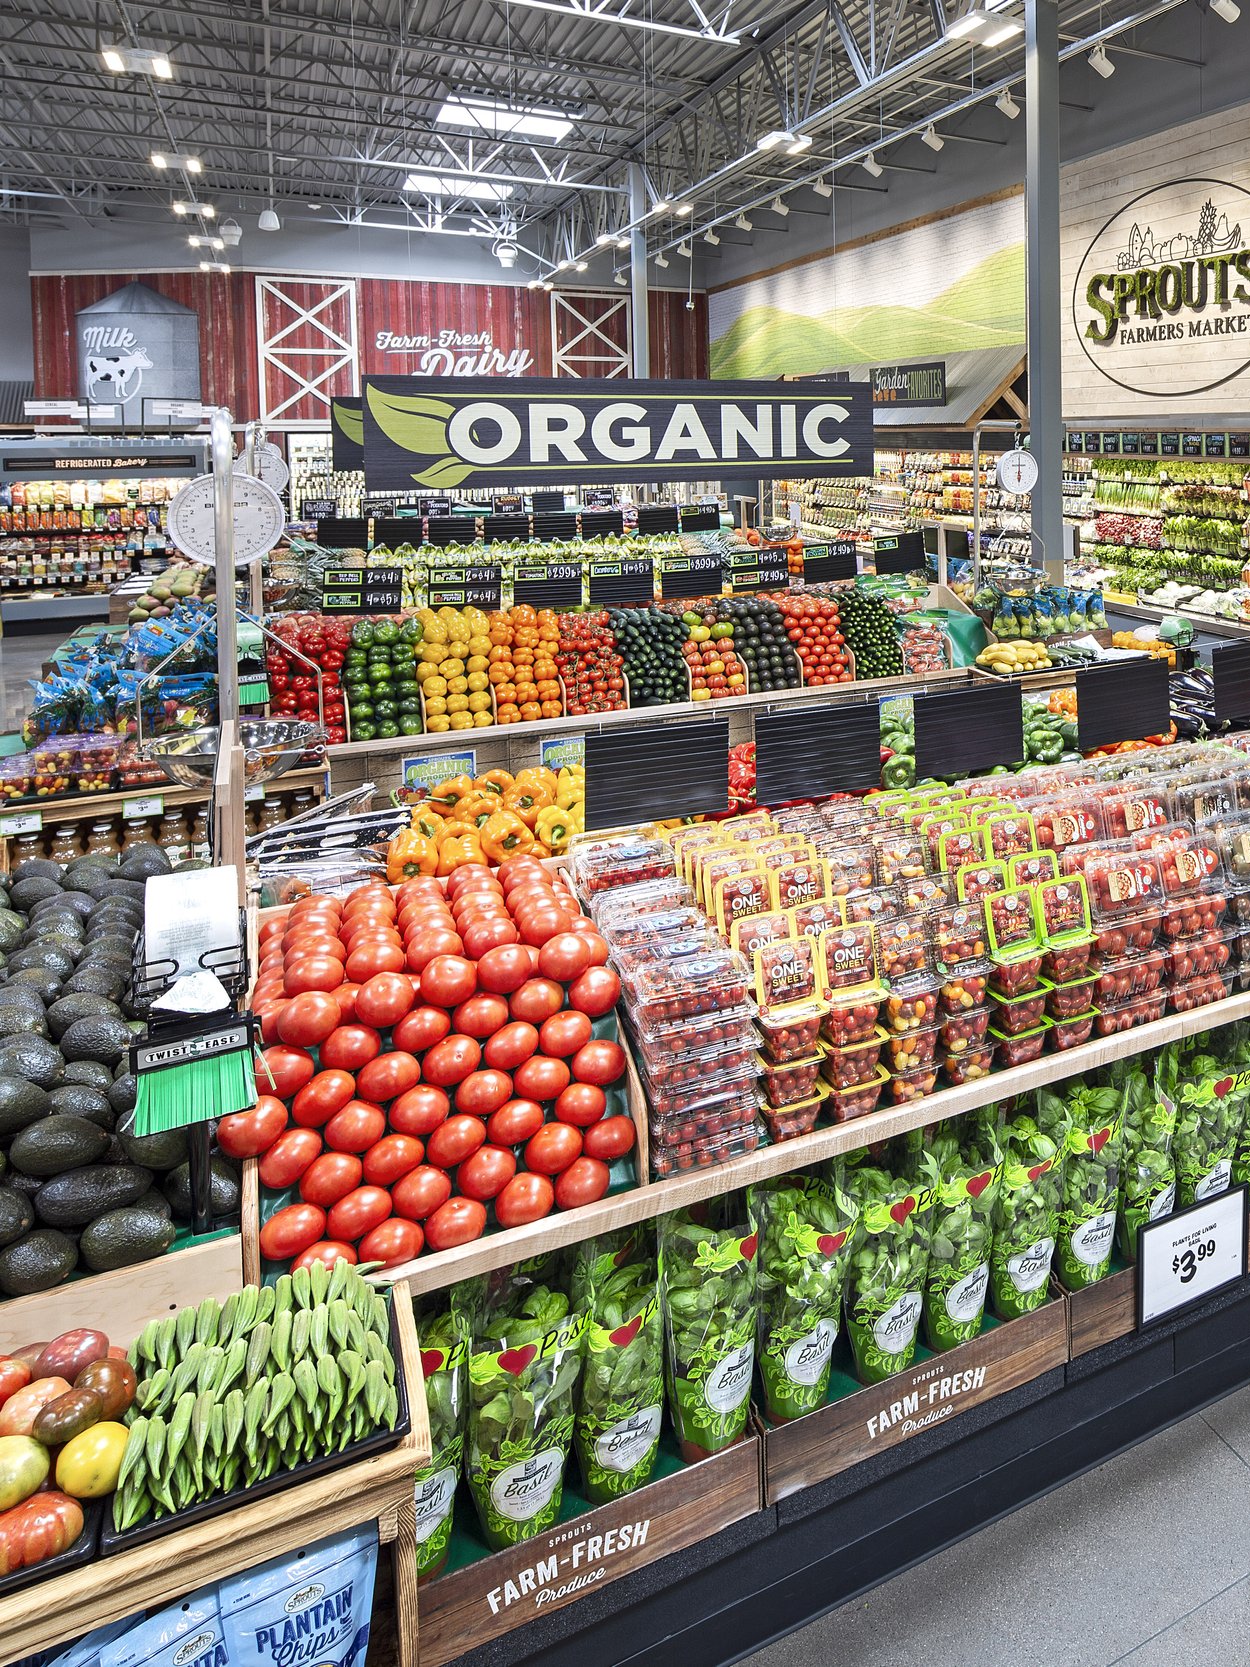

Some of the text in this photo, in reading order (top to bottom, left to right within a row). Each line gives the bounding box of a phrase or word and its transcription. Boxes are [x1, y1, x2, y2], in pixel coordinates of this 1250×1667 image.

[83, 326, 137, 349] Milk
[375, 330, 492, 349] Farm-Fresh
[1120, 322, 1184, 345] FARMERS
[412, 347, 534, 377] Dairy
[875, 366, 943, 399] Garden FAVORITES
[449, 402, 852, 464] ORGANIC
[55, 458, 148, 469] REFRIGERATED Bakery
[367, 571, 394, 584] 2 $4
[466, 570, 471, 581] 2
[623, 563, 629, 575] 4
[366, 593, 392, 606] 4 $5
[466, 590, 473, 602] 2
[406, 758, 472, 780] ORGANIC
[787, 881, 817, 898] ONE
[788, 893, 817, 906] SWEET
[731, 892, 762, 911] ONE
[732, 905, 763, 918] SWEET
[804, 919, 833, 936] ONE
[834, 945, 865, 963] ONE
[834, 959, 865, 971] SWEET
[771, 959, 805, 979] ONE
[772, 974, 805, 987] SWEET
[148, 1034, 237, 1062] TWIST EASE
[1080, 1222, 1113, 1245] Basil
[1172, 1222, 1217, 1248] PLANTS FOR LIVING
[885, 1301, 918, 1336] Basil
[797, 1331, 830, 1365] Basil
[911, 1364, 945, 1386] SPROUTS
[866, 1366, 988, 1440] FARM-FRESH
[901, 1402, 954, 1437] Produce
[607, 1417, 654, 1452] Basil
[503, 1461, 553, 1499] Basil
[415, 1479, 446, 1516] asil
[548, 1521, 593, 1548] SPROUTS
[486, 1520, 651, 1616] FARM-FRESH
[535, 1564, 607, 1609] Produce
[287, 1589, 323, 1612] SPROUTS
[255, 1585, 354, 1653] PLANTAIN
[176, 1635, 213, 1665] SPROUTS
[271, 1624, 341, 1667] Chips
